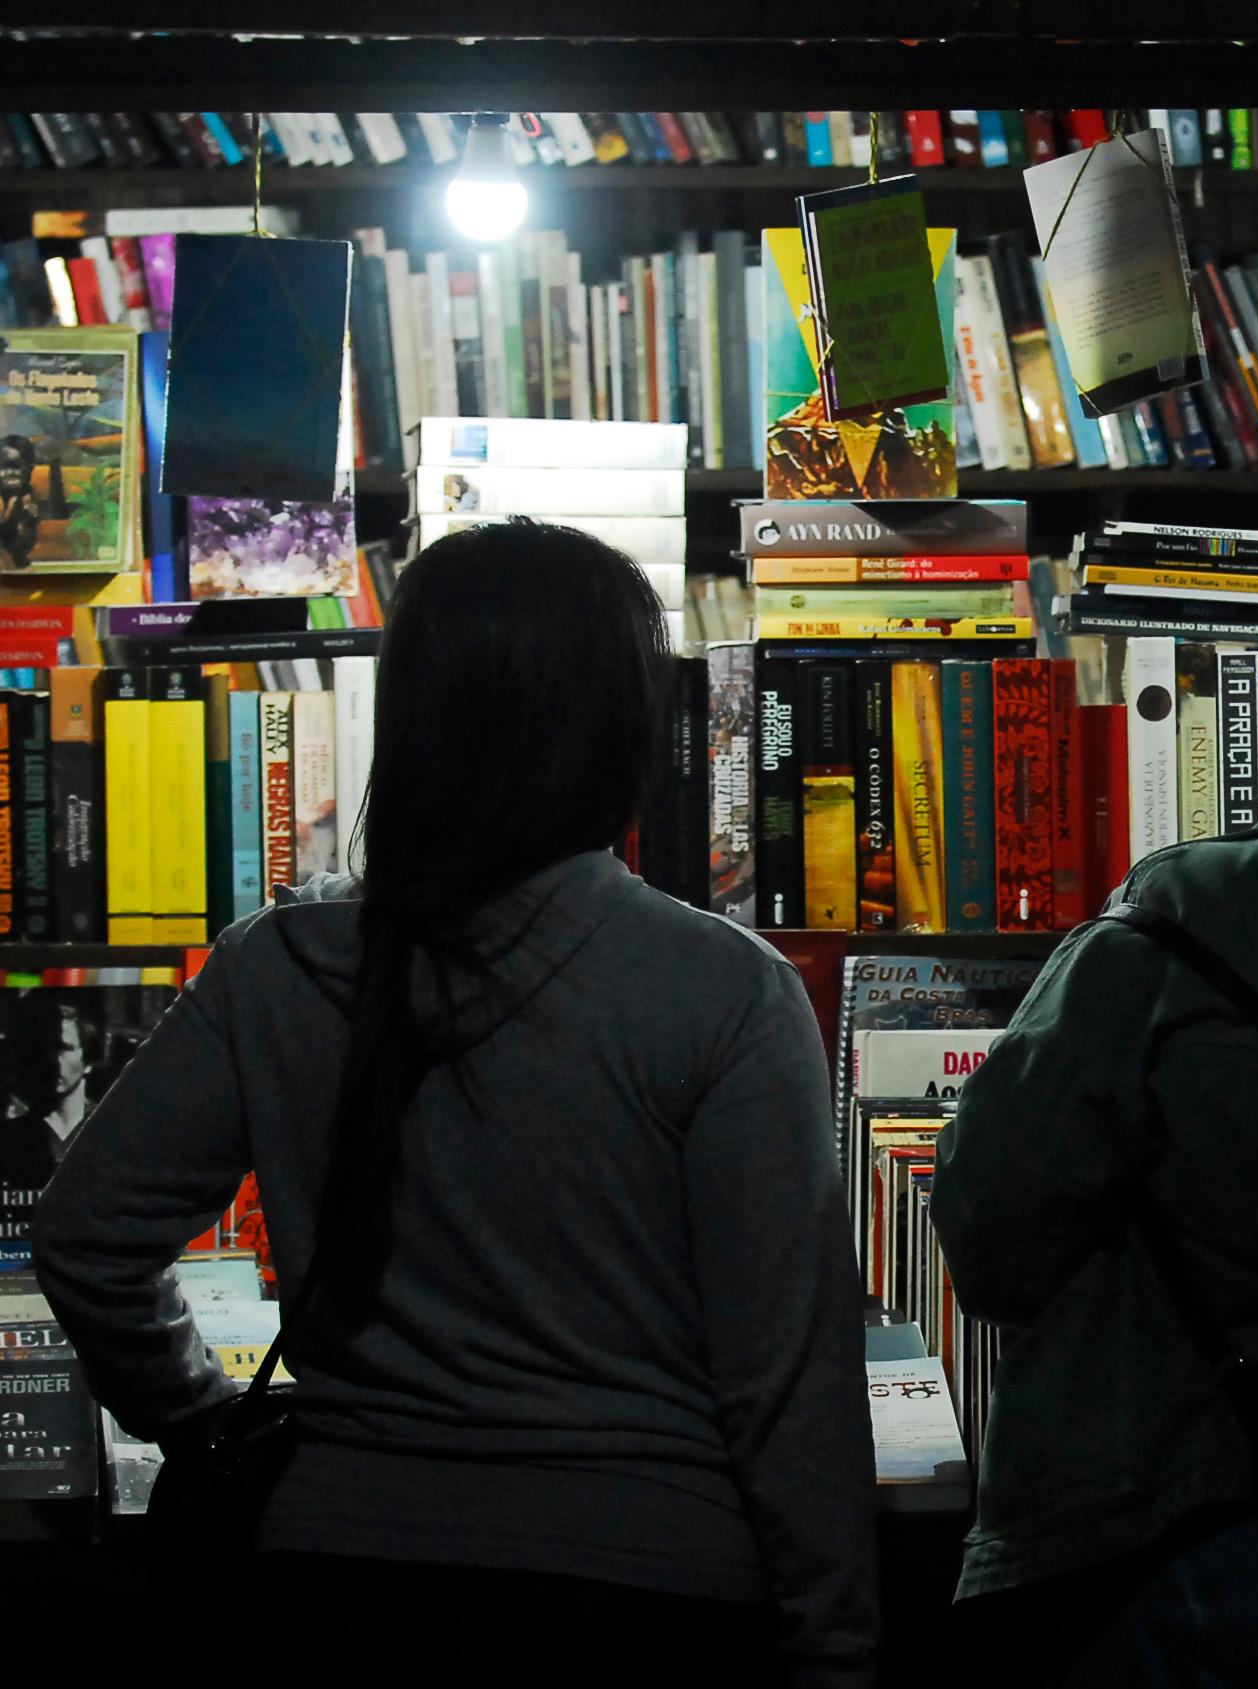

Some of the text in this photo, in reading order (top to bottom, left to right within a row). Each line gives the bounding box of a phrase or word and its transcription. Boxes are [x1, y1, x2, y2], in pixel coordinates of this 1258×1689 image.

[788, 523, 882, 541] AYN RAND
[1154, 526, 1243, 539] NELSON RODRIGUES
[1156, 542, 1171, 551] Por
[862, 559, 932, 569] René Girard: do
[922, 569, 978, 581] hominização
[1140, 619, 1195, 632] ILUSTRADO
[1197, 621, 1210, 632] DE
[266, 704, 277, 754] HALEY
[278, 710, 289, 750] ALEX
[761, 691, 778, 771] PEREGRINO
[777, 704, 793, 757] EU SOU O
[1227, 679, 1253, 824] A PRAÇA E A
[732, 736, 749, 812] HISTORIA
[1057, 739, 1071, 821] Malcolm
[1191, 726, 1208, 839] ENEMY GA
[267, 762, 290, 833] NEGRAS
[714, 755, 732, 835] CRUZADAS
[866, 748, 885, 850] O CÓDEX 632
[913, 761, 931, 867] SECRETUM
[732, 825, 749, 852] LAS
[1057, 827, 1071, 840] X
[857, 960, 1035, 984] GUIA NÁUTIC
[867, 986, 968, 1002] DA COSTA
[0, 1378, 71, 1395] RDNER
